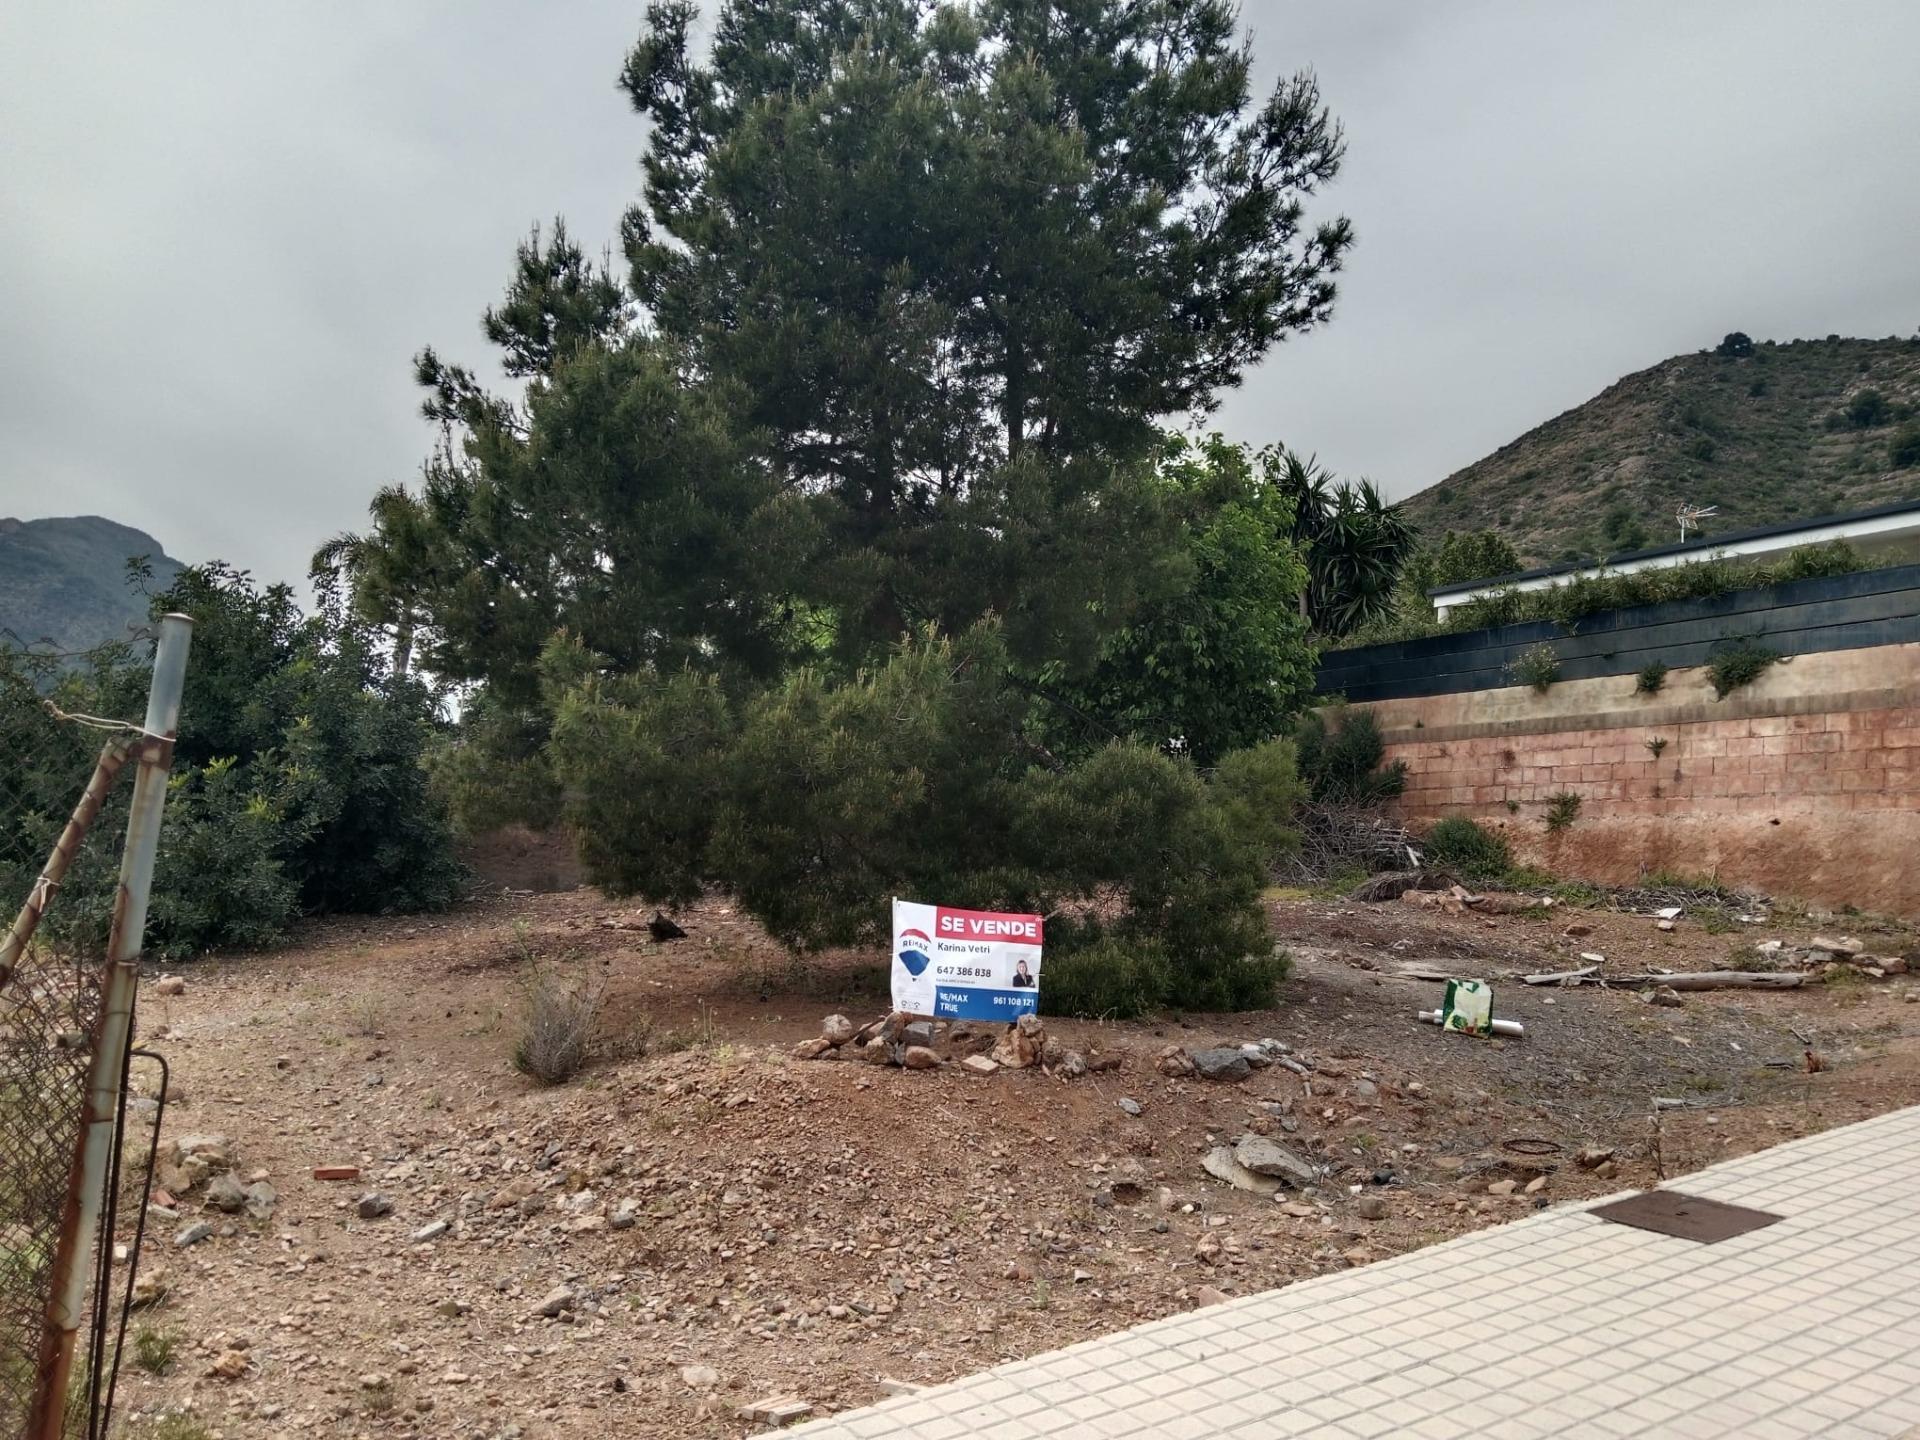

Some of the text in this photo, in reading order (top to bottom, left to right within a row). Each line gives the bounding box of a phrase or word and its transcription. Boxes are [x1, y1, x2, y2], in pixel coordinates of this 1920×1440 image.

[941, 916, 1036, 937] SE VENDE
[938, 943, 990, 954] Karina Vetri
[937, 966, 991, 977] 647 386 838
[940, 993, 968, 1003] RE/MAX
[993, 997, 1006, 1005] 961
[1023, 998, 1034, 1007] 121
[940, 1003, 959, 1012] TRUE
